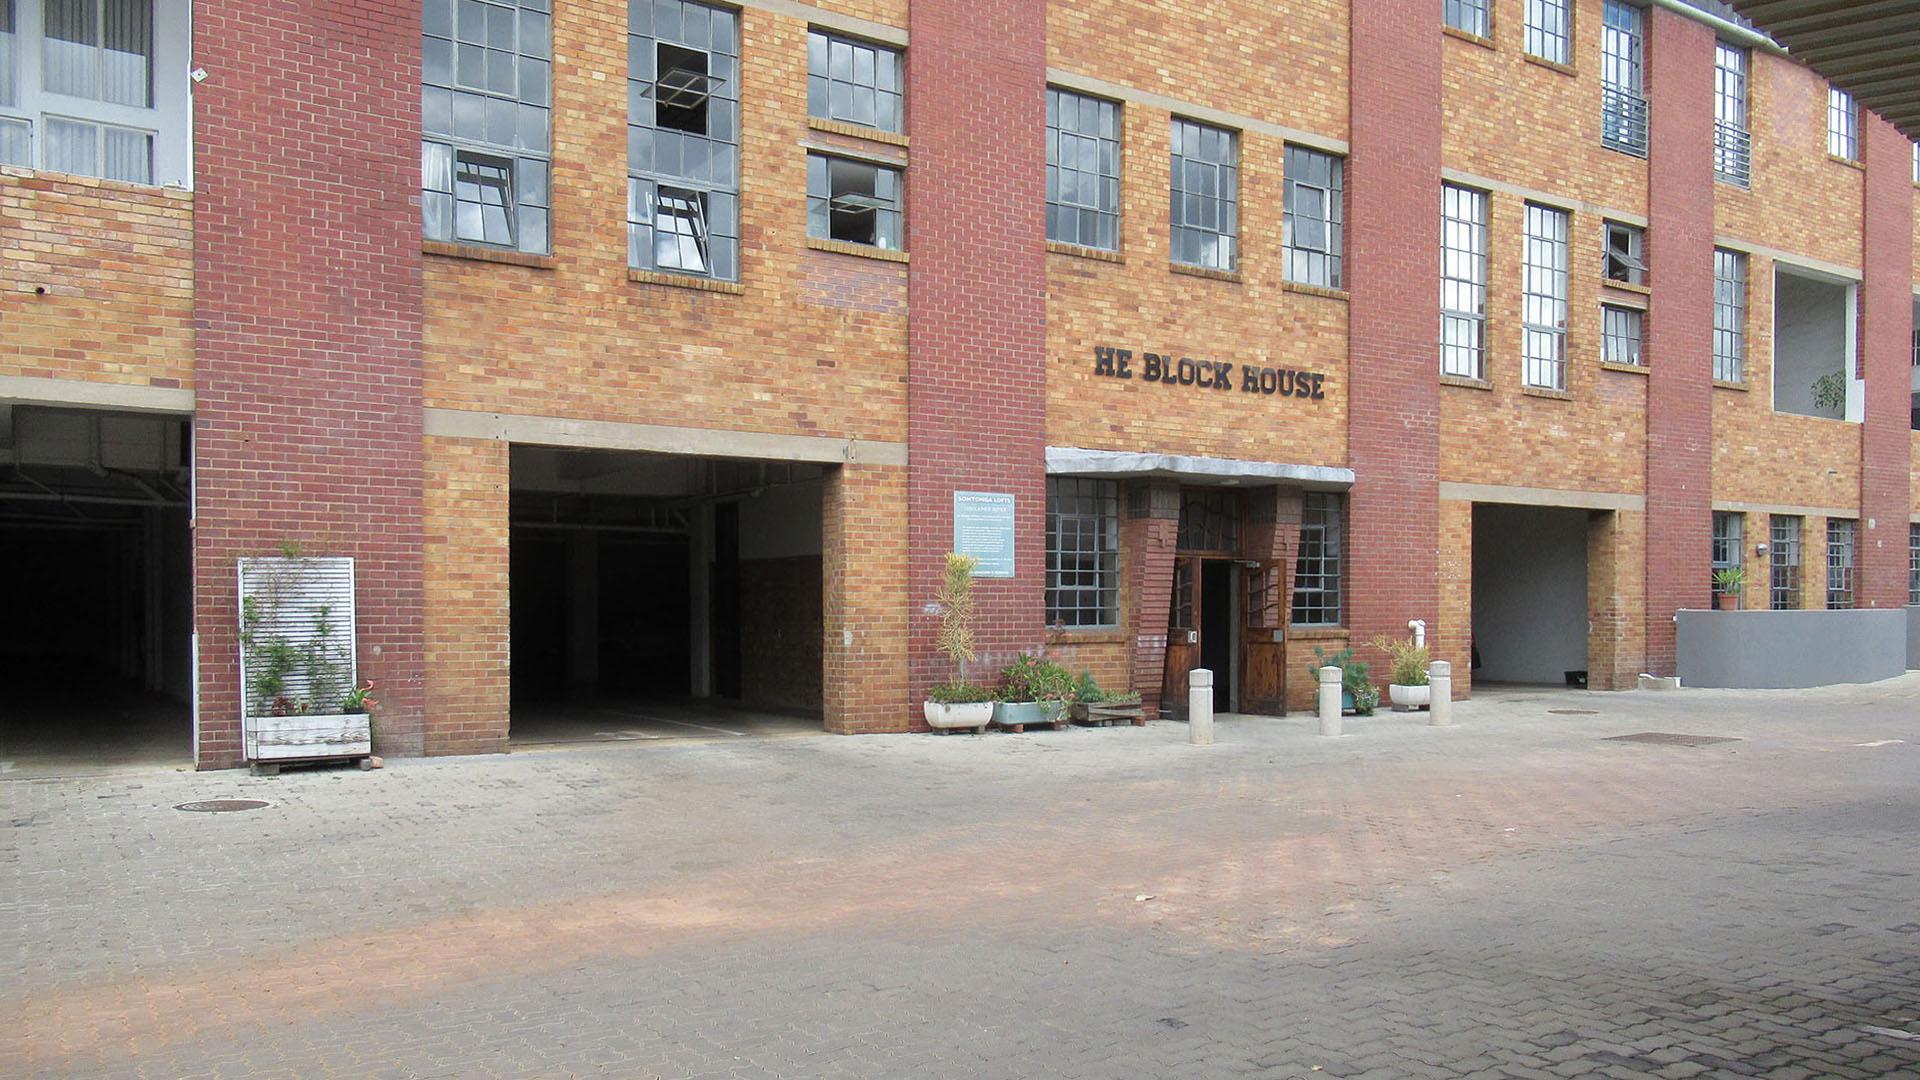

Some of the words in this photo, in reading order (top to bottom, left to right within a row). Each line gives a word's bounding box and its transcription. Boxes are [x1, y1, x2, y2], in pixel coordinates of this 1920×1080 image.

[1095, 346, 1132, 379] HE
[1143, 352, 1232, 390] BLOCK
[1242, 365, 1325, 400] HOUSE
